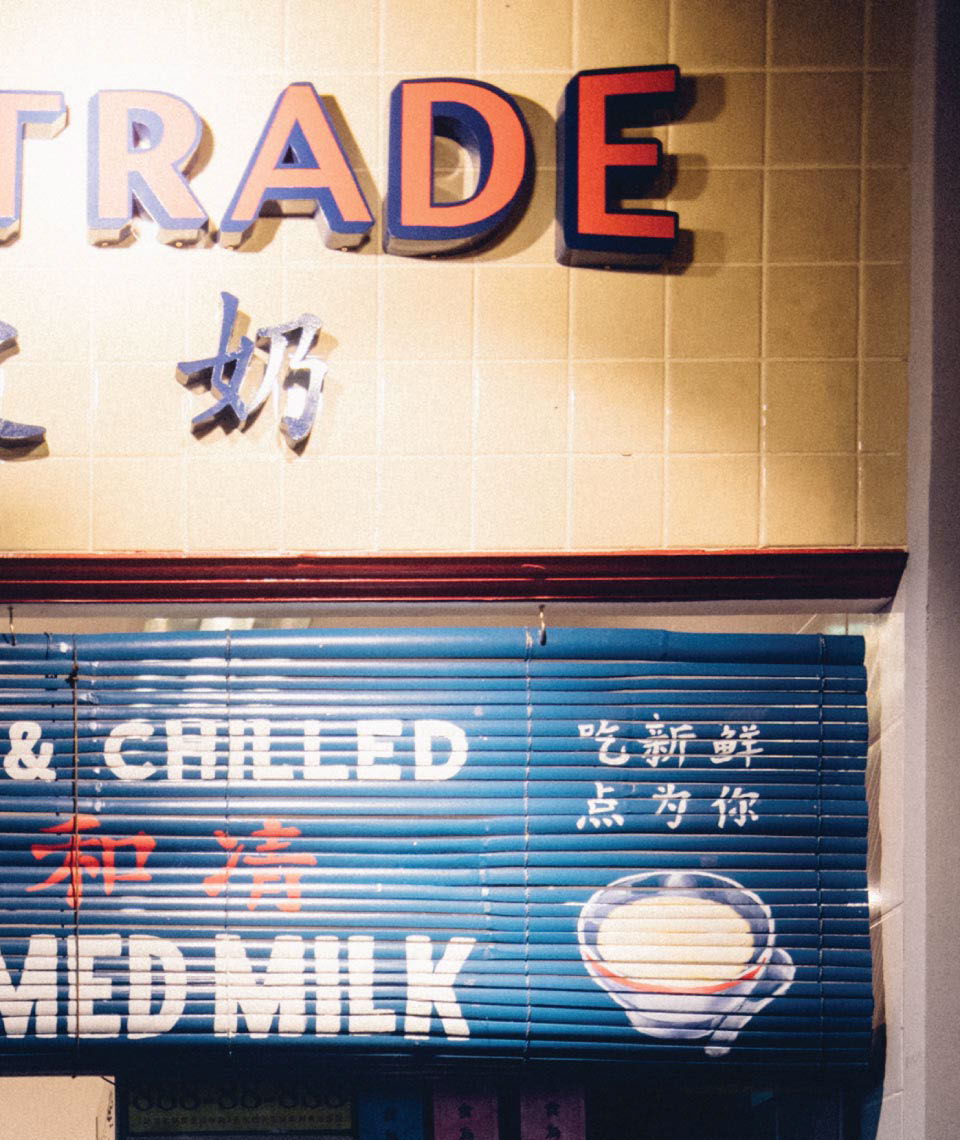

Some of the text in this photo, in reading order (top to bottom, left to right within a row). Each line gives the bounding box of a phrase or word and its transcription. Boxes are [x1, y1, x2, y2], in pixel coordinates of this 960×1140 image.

[3, 720, 57, 782] &
[104, 719, 469, 782] CHILLED
[576, 781, 760, 829] 点为你
[213, 933, 477, 1042] MILK
